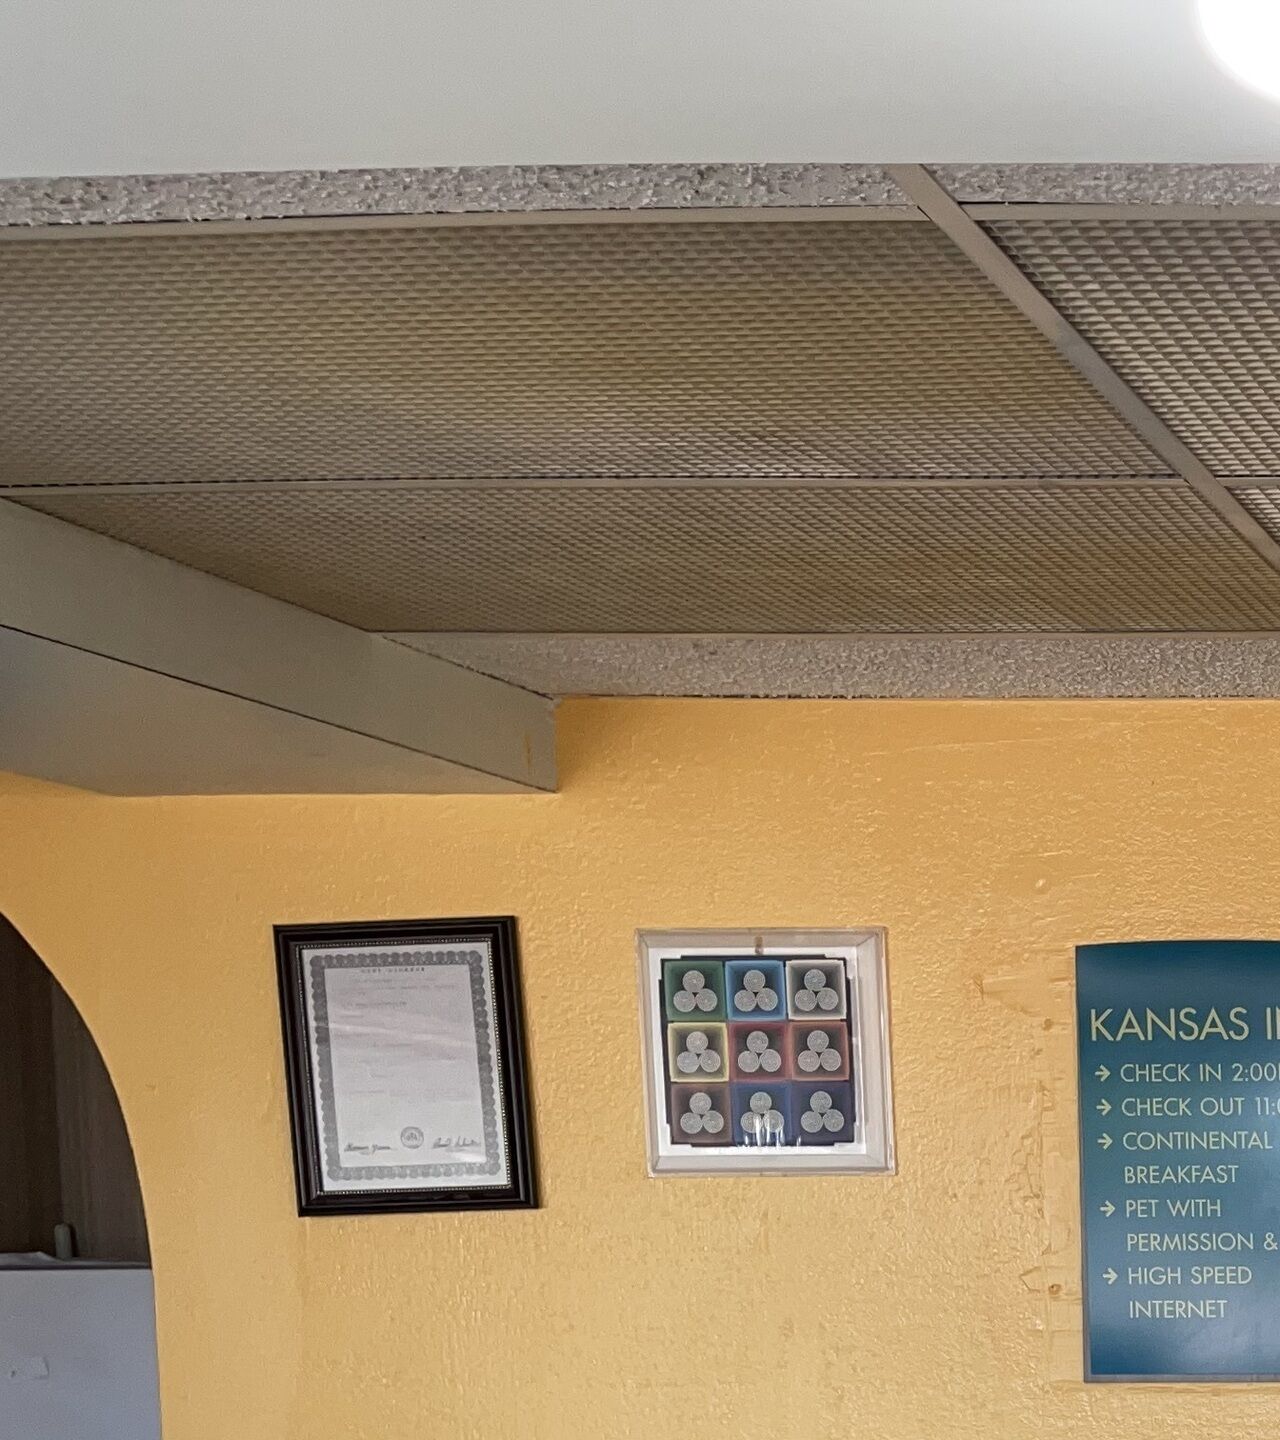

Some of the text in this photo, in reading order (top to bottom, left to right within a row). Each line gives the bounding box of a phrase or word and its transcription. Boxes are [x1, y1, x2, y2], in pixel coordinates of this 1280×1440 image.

[1090, 1006, 1249, 1043] KANSAS
[1120, 1063, 1191, 1083] CHECK
[1200, 1063, 1222, 1082] IN
[1122, 1097, 1192, 1117] CHECK
[1201, 1097, 1244, 1117] OUT
[1122, 1131, 1274, 1151] CONTINENTAL
[1124, 1165, 1239, 1185] BREAKFAST
[1126, 1199, 1222, 1218] PET WITH
[1127, 1233, 1254, 1252] PERMISSION
[1263, 1233, 1279, 1251] &
[1128, 1266, 1252, 1286] HIGH SPEED
[1129, 1300, 1228, 1320] INTERNET
